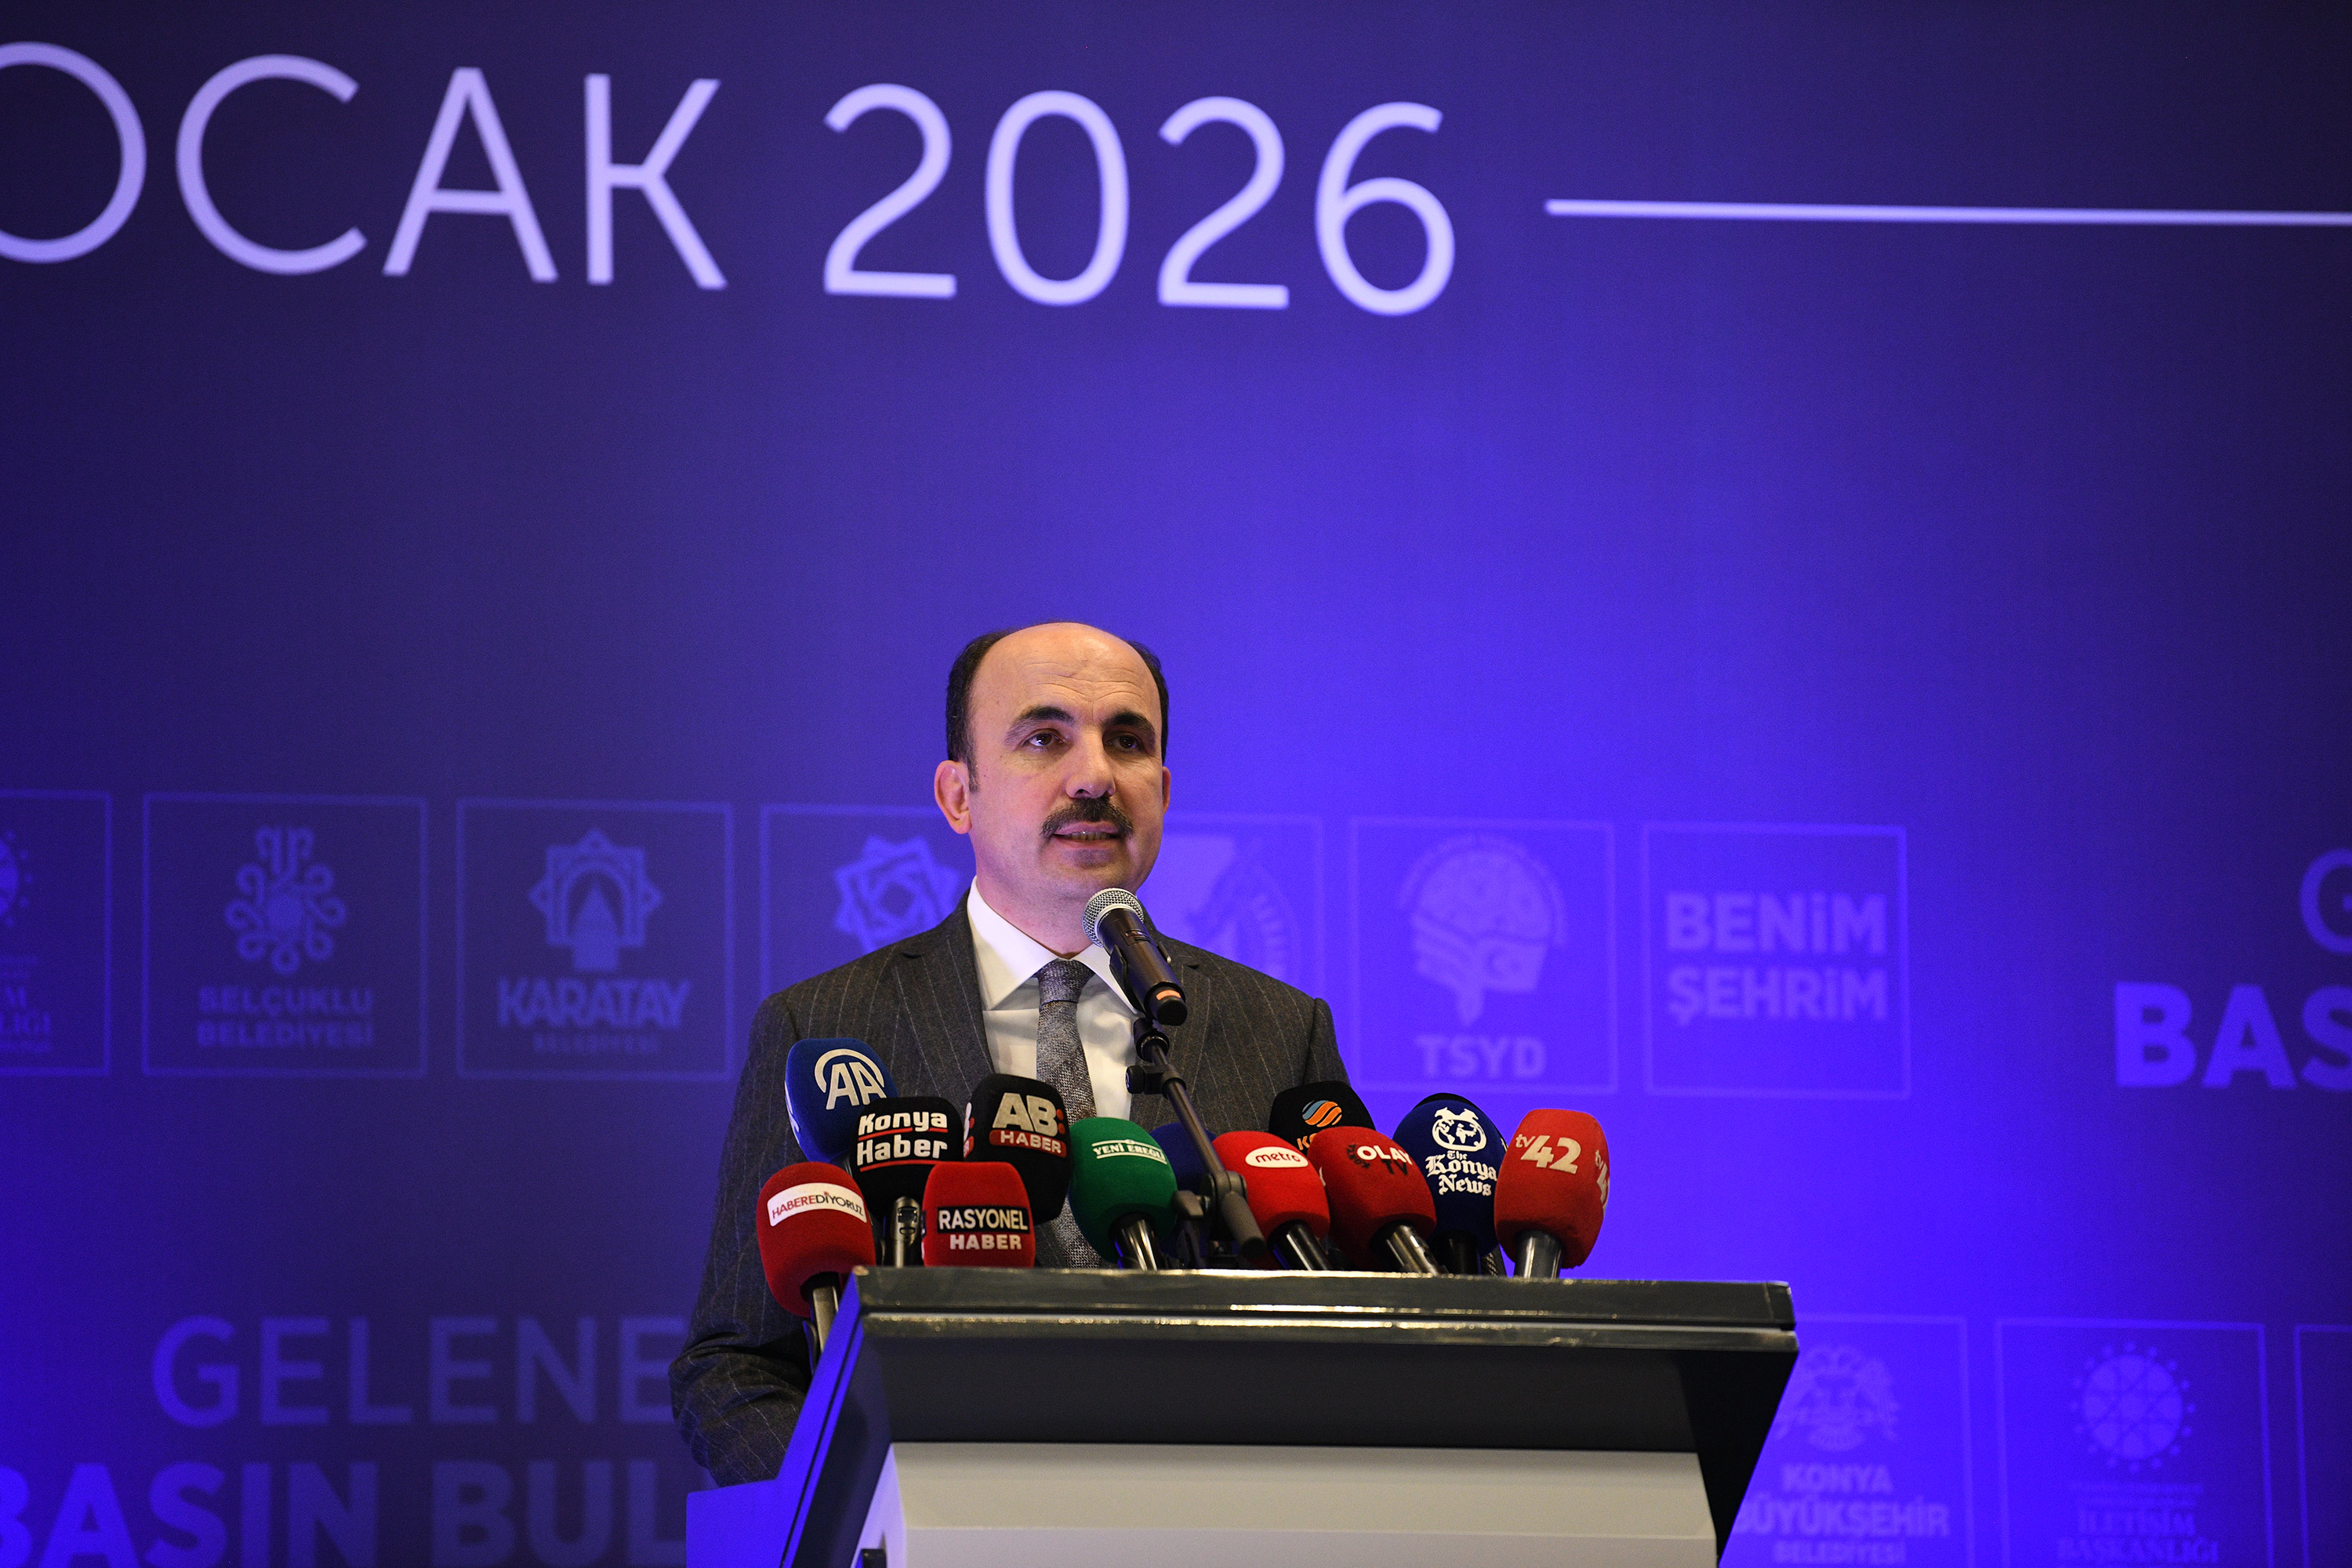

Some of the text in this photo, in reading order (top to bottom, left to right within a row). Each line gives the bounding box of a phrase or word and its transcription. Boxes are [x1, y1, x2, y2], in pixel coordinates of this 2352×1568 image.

[0, 42, 1456, 316] OCAK 2026
[497, 975, 691, 1029] KARATAY
[1415, 1035, 1547, 1079] TSYD
[826, 1062, 887, 1110] AA
[858, 1111, 948, 1136] Konya
[857, 1134, 948, 1166] Haber
[1000, 1131, 1062, 1154] HABER
[1446, 1150, 1468, 1160] The
[1255, 1152, 1301, 1163] metro
[1381, 1159, 1408, 1176] TV
[1425, 1153, 1497, 1181] Konya
[1438, 1174, 1492, 1196] News
[938, 1208, 1029, 1230] RASYONEL
[949, 1234, 1022, 1250] HABER
[1782, 1462, 1894, 1495] KONYA
